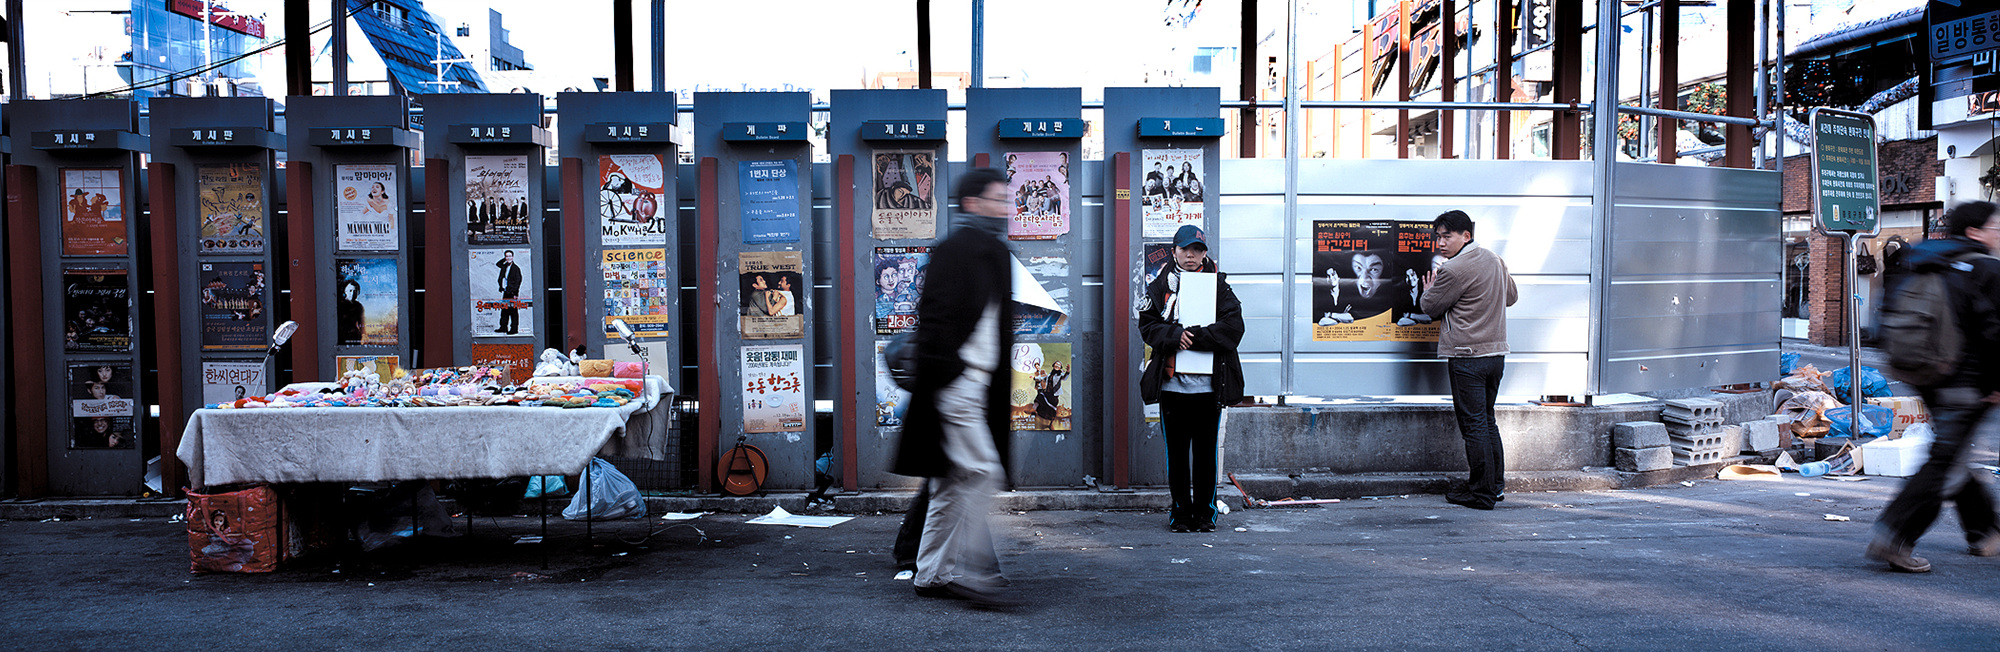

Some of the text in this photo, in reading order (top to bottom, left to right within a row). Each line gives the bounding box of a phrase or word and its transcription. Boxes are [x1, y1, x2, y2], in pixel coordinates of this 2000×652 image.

[470, 126, 511, 138] 게시판
[607, 126, 648, 137] 게시판
[885, 123, 926, 134] 게시판
[1023, 122, 1063, 132] 게시판
[193, 130, 233, 141] 게시판
[331, 129, 371, 140] 게시판
[354, 171, 392, 181] 맘마미아!
[749, 169, 787, 178] 1번지 단상
[346, 223, 390, 234] MAMMA MIA!
[1317, 240, 1368, 252] 빨간피터
[1398, 241, 1440, 253] 빨간피
[606, 251, 663, 262] science
[746, 352, 763, 362] 웃음!
[781, 350, 798, 361] 재미!
[746, 378, 766, 394] 우동
